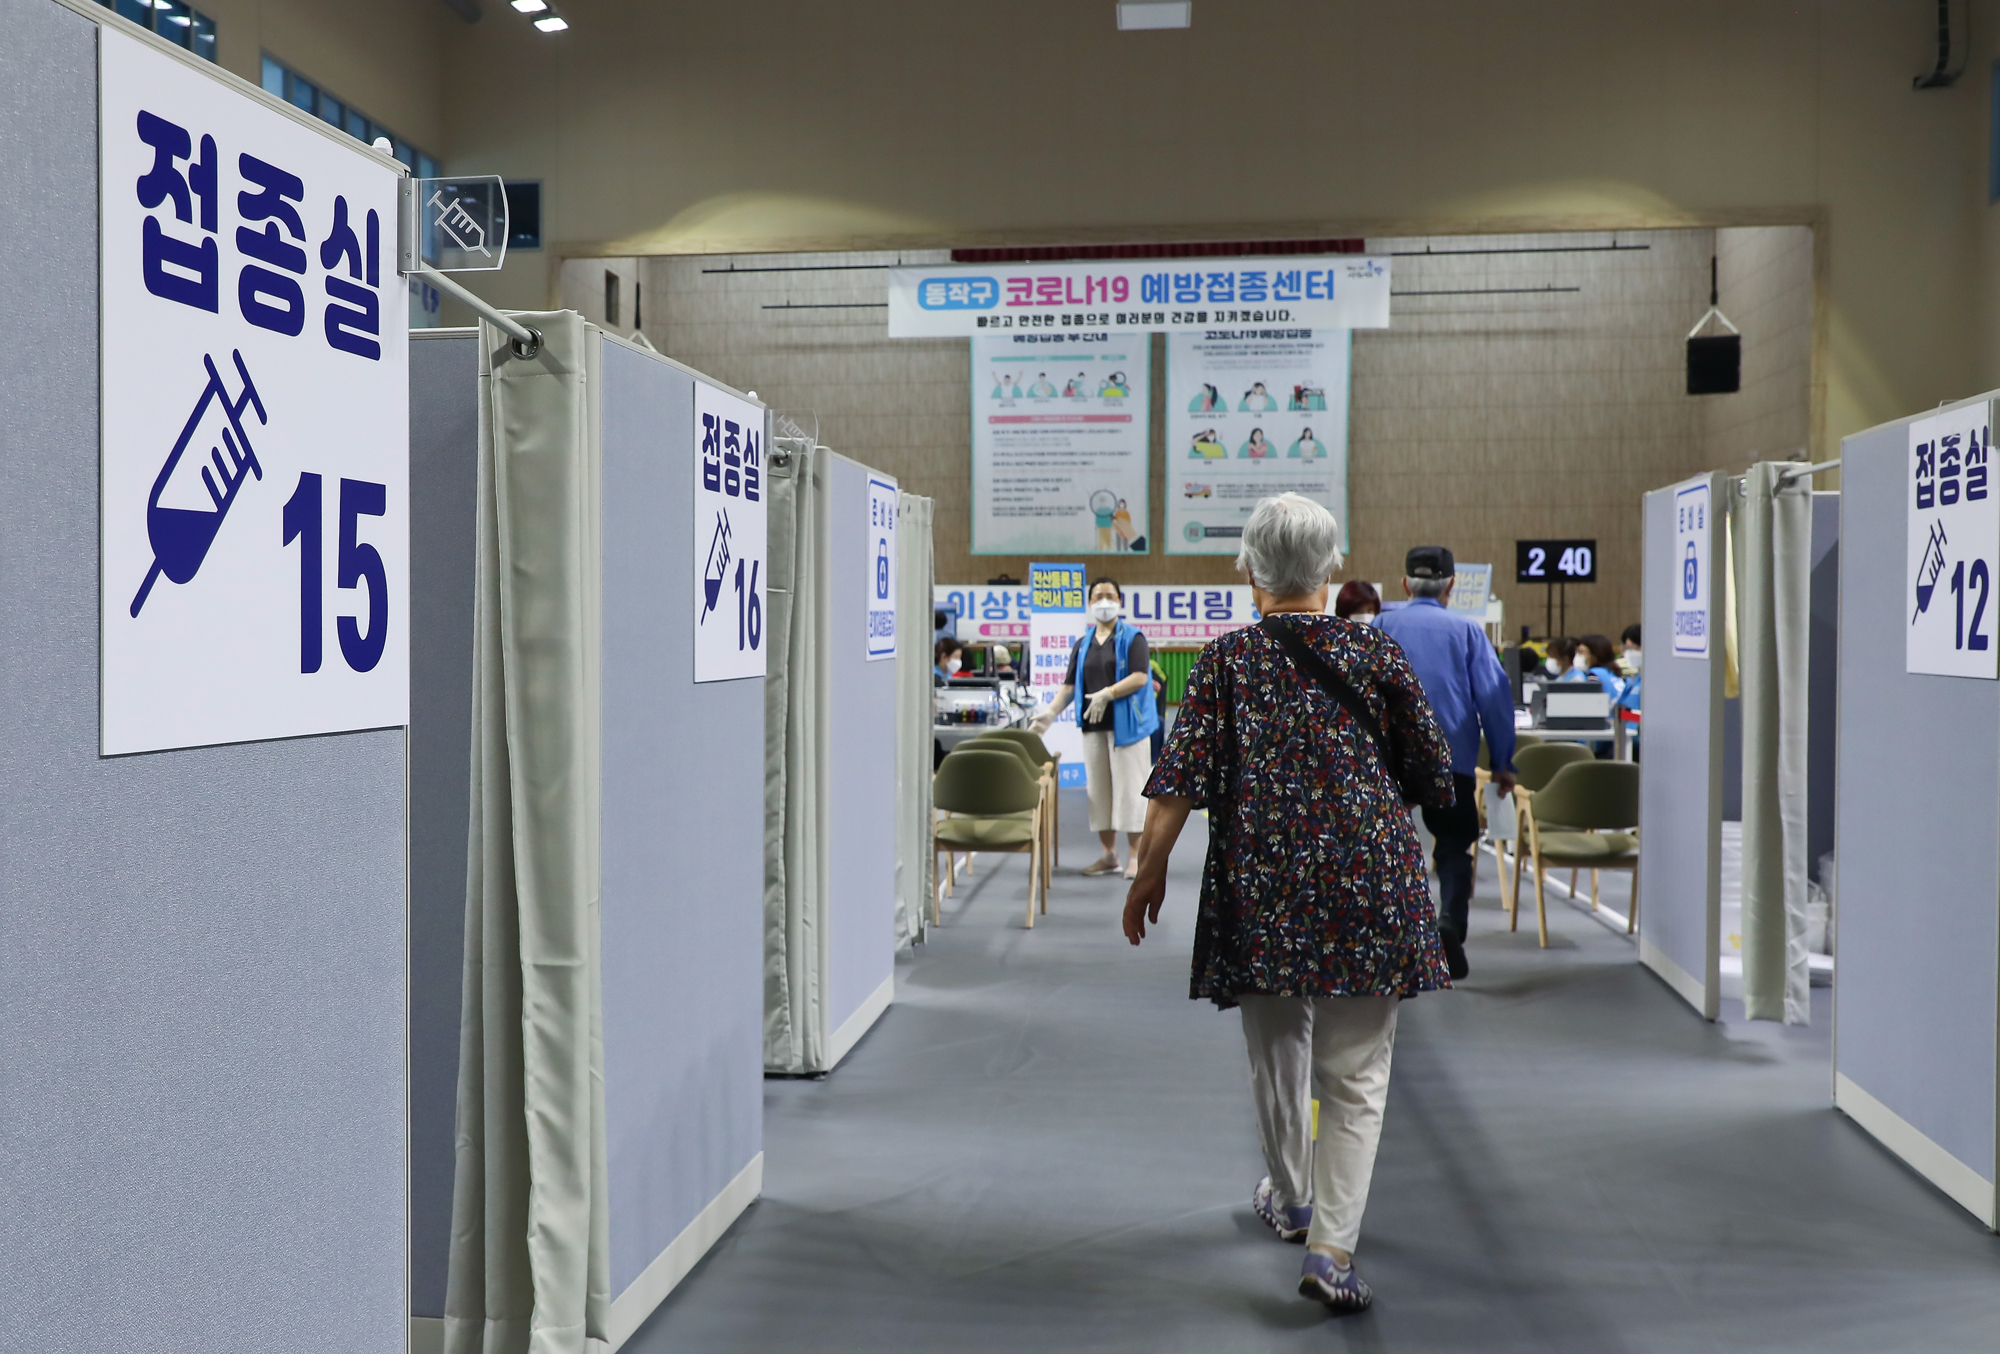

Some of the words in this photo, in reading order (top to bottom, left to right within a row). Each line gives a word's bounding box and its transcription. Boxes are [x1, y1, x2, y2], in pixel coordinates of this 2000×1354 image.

[136, 109, 381, 361] 접종실
[925, 282, 992, 306] 동작구
[1006, 275, 1129, 307] 코로나19
[1141, 269, 1334, 304] 예방접종센터
[977, 315, 1013, 328] 빠르고
[1019, 314, 1055, 327] 안전한
[1061, 313, 1109, 326] 접종으로
[1116, 312, 1164, 325] 여러분의
[1171, 311, 1207, 324] 건강을
[1214, 310, 1295, 323] 지키겠습니다.
[702, 412, 759, 502] 접종실
[1916, 425, 1988, 509] 접종실
[282, 470, 389, 674] 15
[1033, 571, 1071, 588] 전산등록
[1033, 590, 1062, 607] 확인서
[1557, 546, 1592, 576] 40
[734, 558, 761, 651] 16
[1951, 558, 1989, 651] 12
